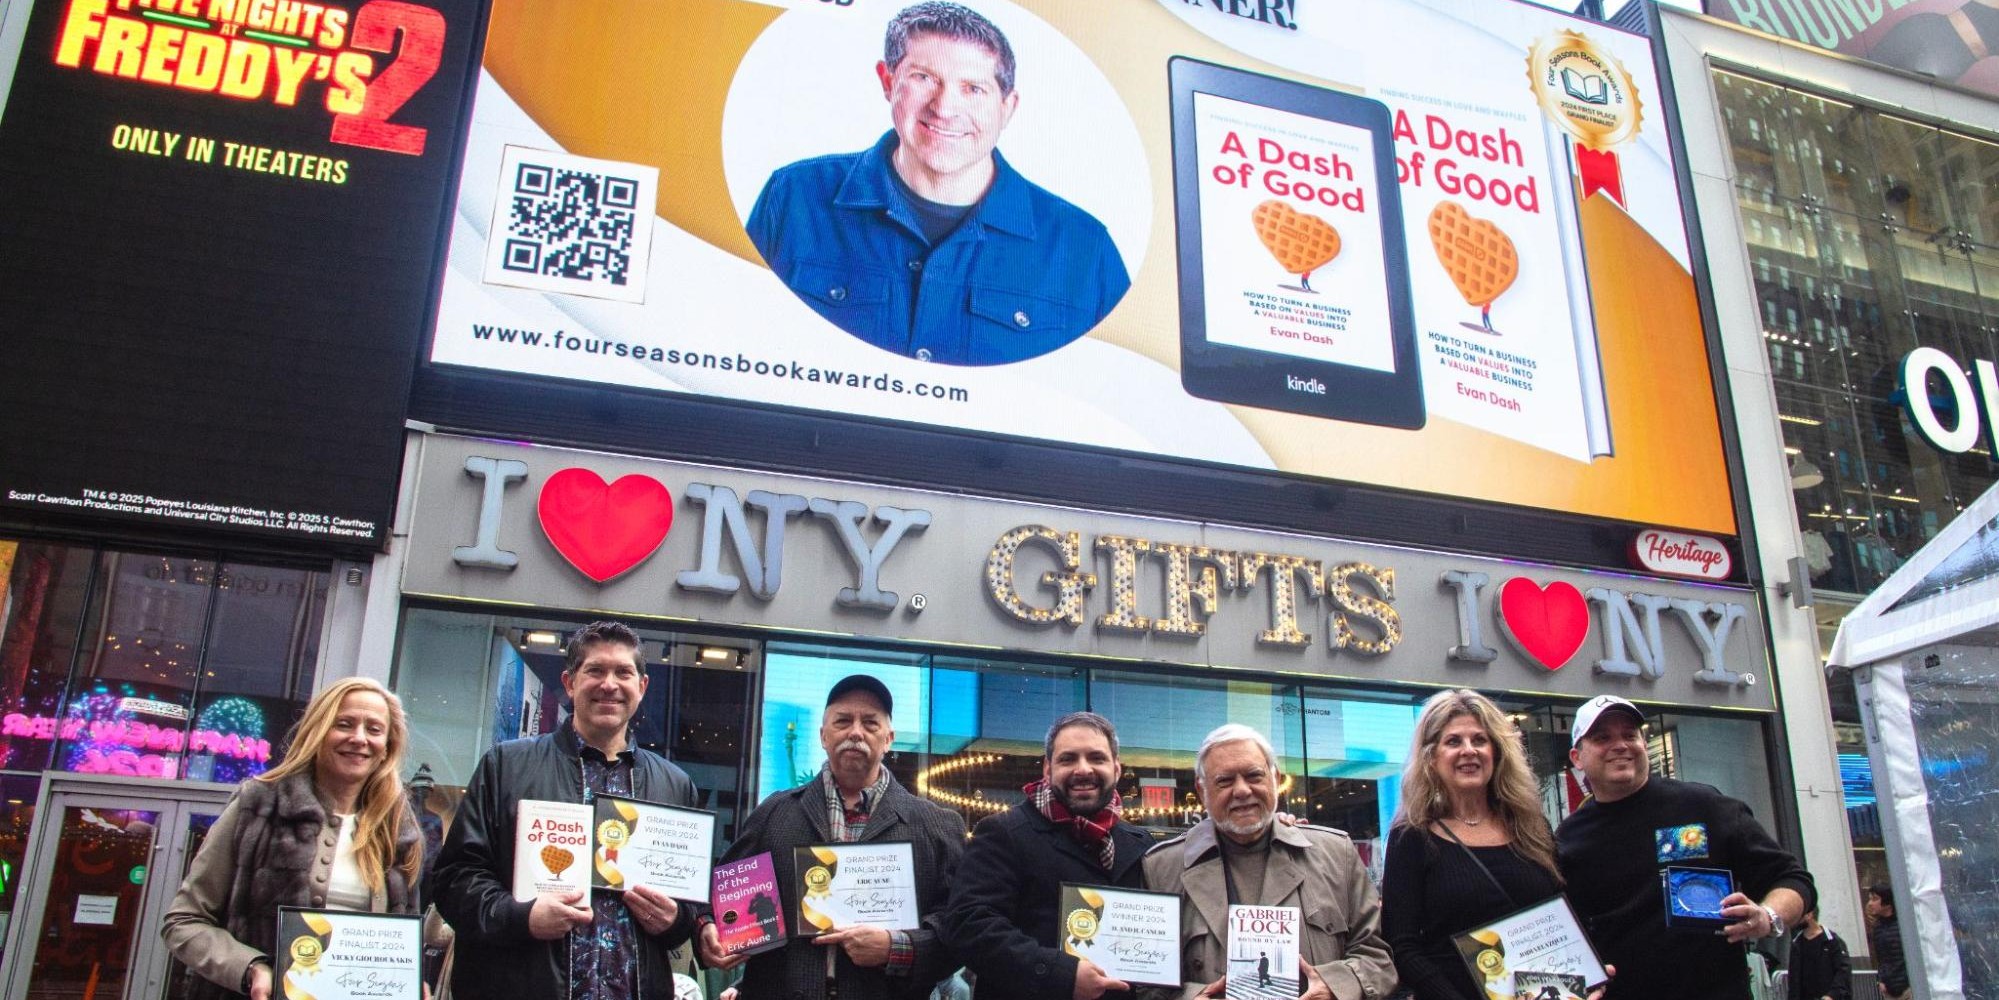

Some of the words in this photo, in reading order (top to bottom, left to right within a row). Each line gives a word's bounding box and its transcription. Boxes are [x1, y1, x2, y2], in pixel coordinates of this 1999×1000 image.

[203, 0, 349, 49] NIGHTS
[220, 22, 239, 37] AT
[55, 0, 373, 115] FREDDY'S
[330, 0, 447, 156] 2
[1580, 51, 1601, 69] Book
[1602, 69, 1623, 104] Awards
[1393, 109, 1418, 145] A
[1426, 114, 1524, 167] Dash
[112, 124, 182, 158] ONLY
[186, 136, 217, 164] IN
[223, 141, 349, 184] THEATERS
[1220, 131, 1248, 158] A
[1258, 137, 1354, 181] Dash
[1212, 163, 1254, 188] of
[1263, 170, 1364, 213] Good
[1395, 151, 1425, 187] of
[1434, 158, 1540, 213] Good
[1243, 291, 1264, 300] HOW
[1280, 297, 1303, 307] TURN
[1313, 304, 1351, 316] BUSINESS
[1249, 300, 1276, 310] BASED
[1279, 305, 1291, 313] ON
[1294, 308, 1324, 319] VALUES
[1327, 314, 1347, 323] INTO
[1262, 311, 1304, 324] VALUABLE
[1307, 318, 1346, 331] BUSINESS
[1270, 326, 1299, 339] Evan
[1303, 332, 1333, 345] Dash
[1428, 331, 1449, 344] HOW
[1450, 337, 1461, 347] TO
[1464, 340, 1486, 354] TURN
[1489, 348, 1494, 356] A
[1496, 350, 1537, 369] BUSINESS
[1435, 344, 1460, 358] BASED
[1464, 353, 1476, 363] ON
[1478, 357, 1509, 373] VALUES
[1512, 366, 1533, 379] INTO
[472, 323, 969, 402] www.fourseasonsbookawards.com
[1287, 374, 1326, 394] kindle
[1448, 359, 1490, 379] VALUABLE
[1492, 372, 1533, 391] BUSINESS
[1457, 382, 1486, 401] Evan
[1490, 392, 1521, 412] Dash
[9, 490, 36, 501] Scott
[37, 494, 82, 506] Cawthon
[84, 499, 143, 514] Productions
[144, 506, 163, 515] and
[164, 508, 208, 520] Universal
[209, 514, 228, 524] City
[229, 515, 264, 527] Studios
[265, 520, 285, 528] LLC.
[286, 522, 298, 530] All
[300, 523, 328, 534] Rights
[329, 525, 374, 538] Reserved.
[82, 489, 98, 498] TM
[99, 491, 107, 500] &
[119, 494, 144, 504] 2025
[145, 496, 185, 511] Popeyes
[186, 500, 230, 514] Louisiana
[231, 506, 268, 518] Kitchen,
[269, 510, 286, 519] Inc.
[298, 513, 321, 523] 2025
[322, 516, 330, 524] S.
[452, 455, 528, 570] I
[675, 481, 932, 612] NY
[1644, 532, 1723, 572] Heritage
[984, 523, 1401, 656] GIFTS
[1440, 568, 1498, 663] I
[1585, 586, 1747, 687] NY
[531, 819, 542, 830] A
[546, 819, 583, 833] Dash
[645, 826, 677, 838] WINNER
[679, 831, 699, 840] 2024
[646, 816, 675, 826] GRAND
[677, 820, 698, 830] PRIZE
[528, 832, 544, 842] of
[547, 833, 586, 845] Good
[715, 869, 735, 879] The
[737, 859, 758, 873] End
[844, 866, 879, 874] FINALIST
[846, 855, 875, 863] GRAND
[717, 880, 728, 891] of
[731, 876, 749, 887] the
[719, 881, 773, 902] Beginning
[1111, 913, 1144, 923] WINNER
[1112, 902, 1141, 911] GRAND
[1143, 905, 1165, 914] PRIZE
[1235, 908, 1297, 922] GABRIEL
[342, 928, 376, 938] GRAND
[377, 929, 404, 940] PRIZE
[1239, 919, 1293, 935] LOCK
[1507, 922, 1535, 937] GRAND
[1536, 914, 1557, 926] PRIZE
[339, 939, 380, 950] FINALIST
[382, 941, 405, 950] 2024
[727, 942, 745, 952] Eric
[747, 933, 771, 947] Aune
[331, 953, 354, 961] VICKY
